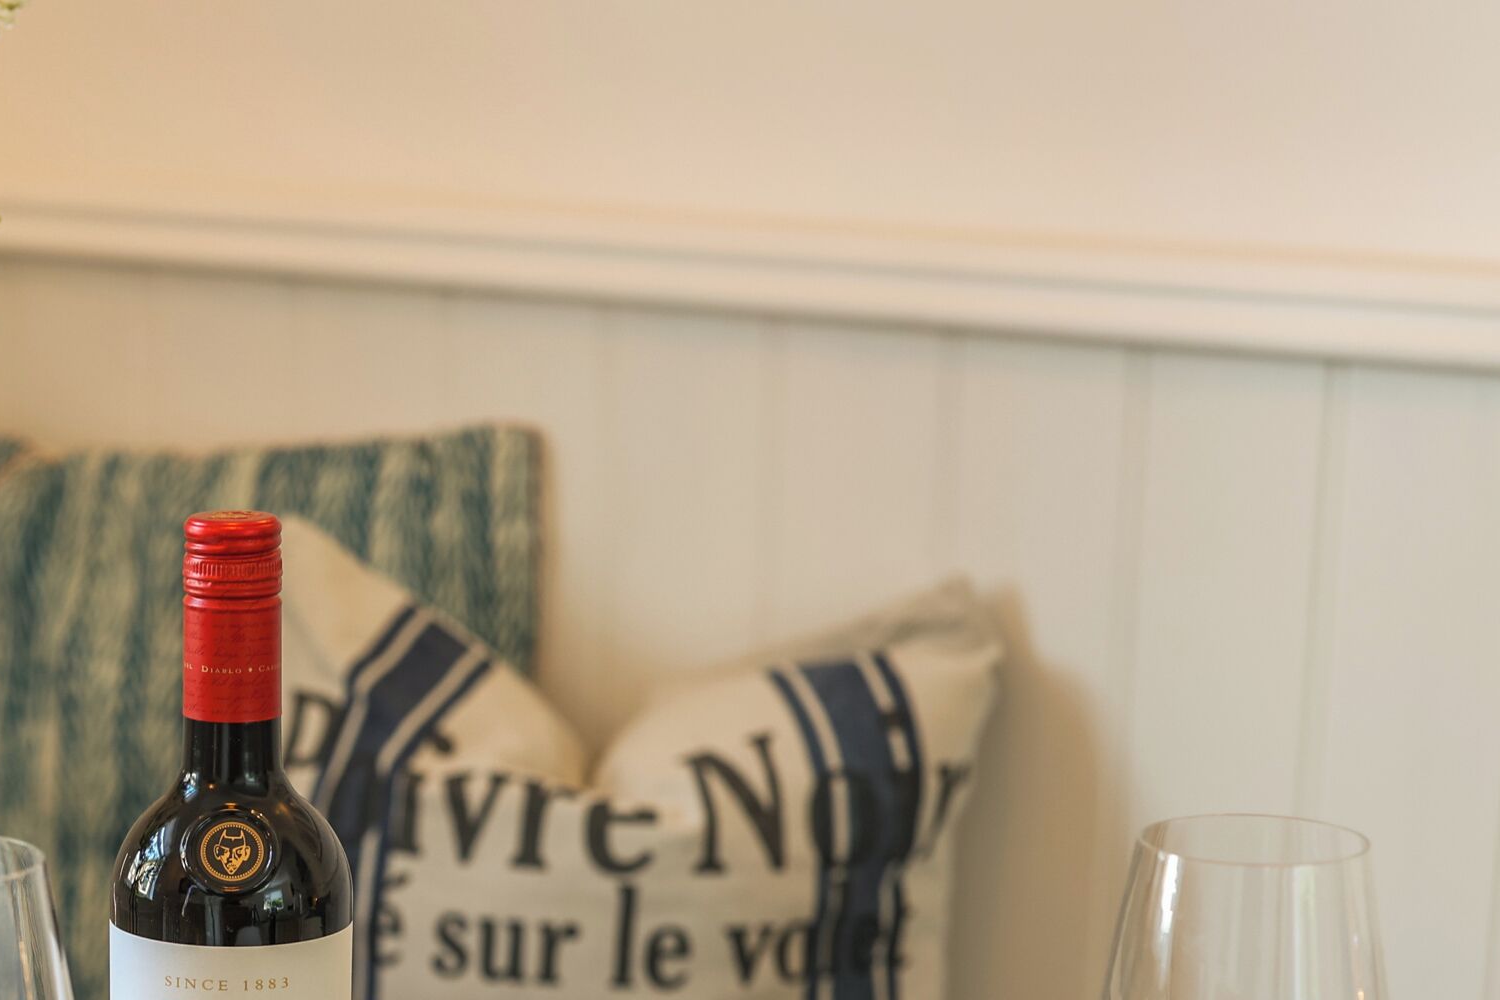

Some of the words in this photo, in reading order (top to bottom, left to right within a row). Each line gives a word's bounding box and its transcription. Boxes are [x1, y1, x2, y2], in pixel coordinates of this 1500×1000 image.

[431, 907, 582, 985] sur
[608, 882, 694, 992] le
[164, 975, 229, 992] SINCE
[243, 976, 290, 992] 1883
